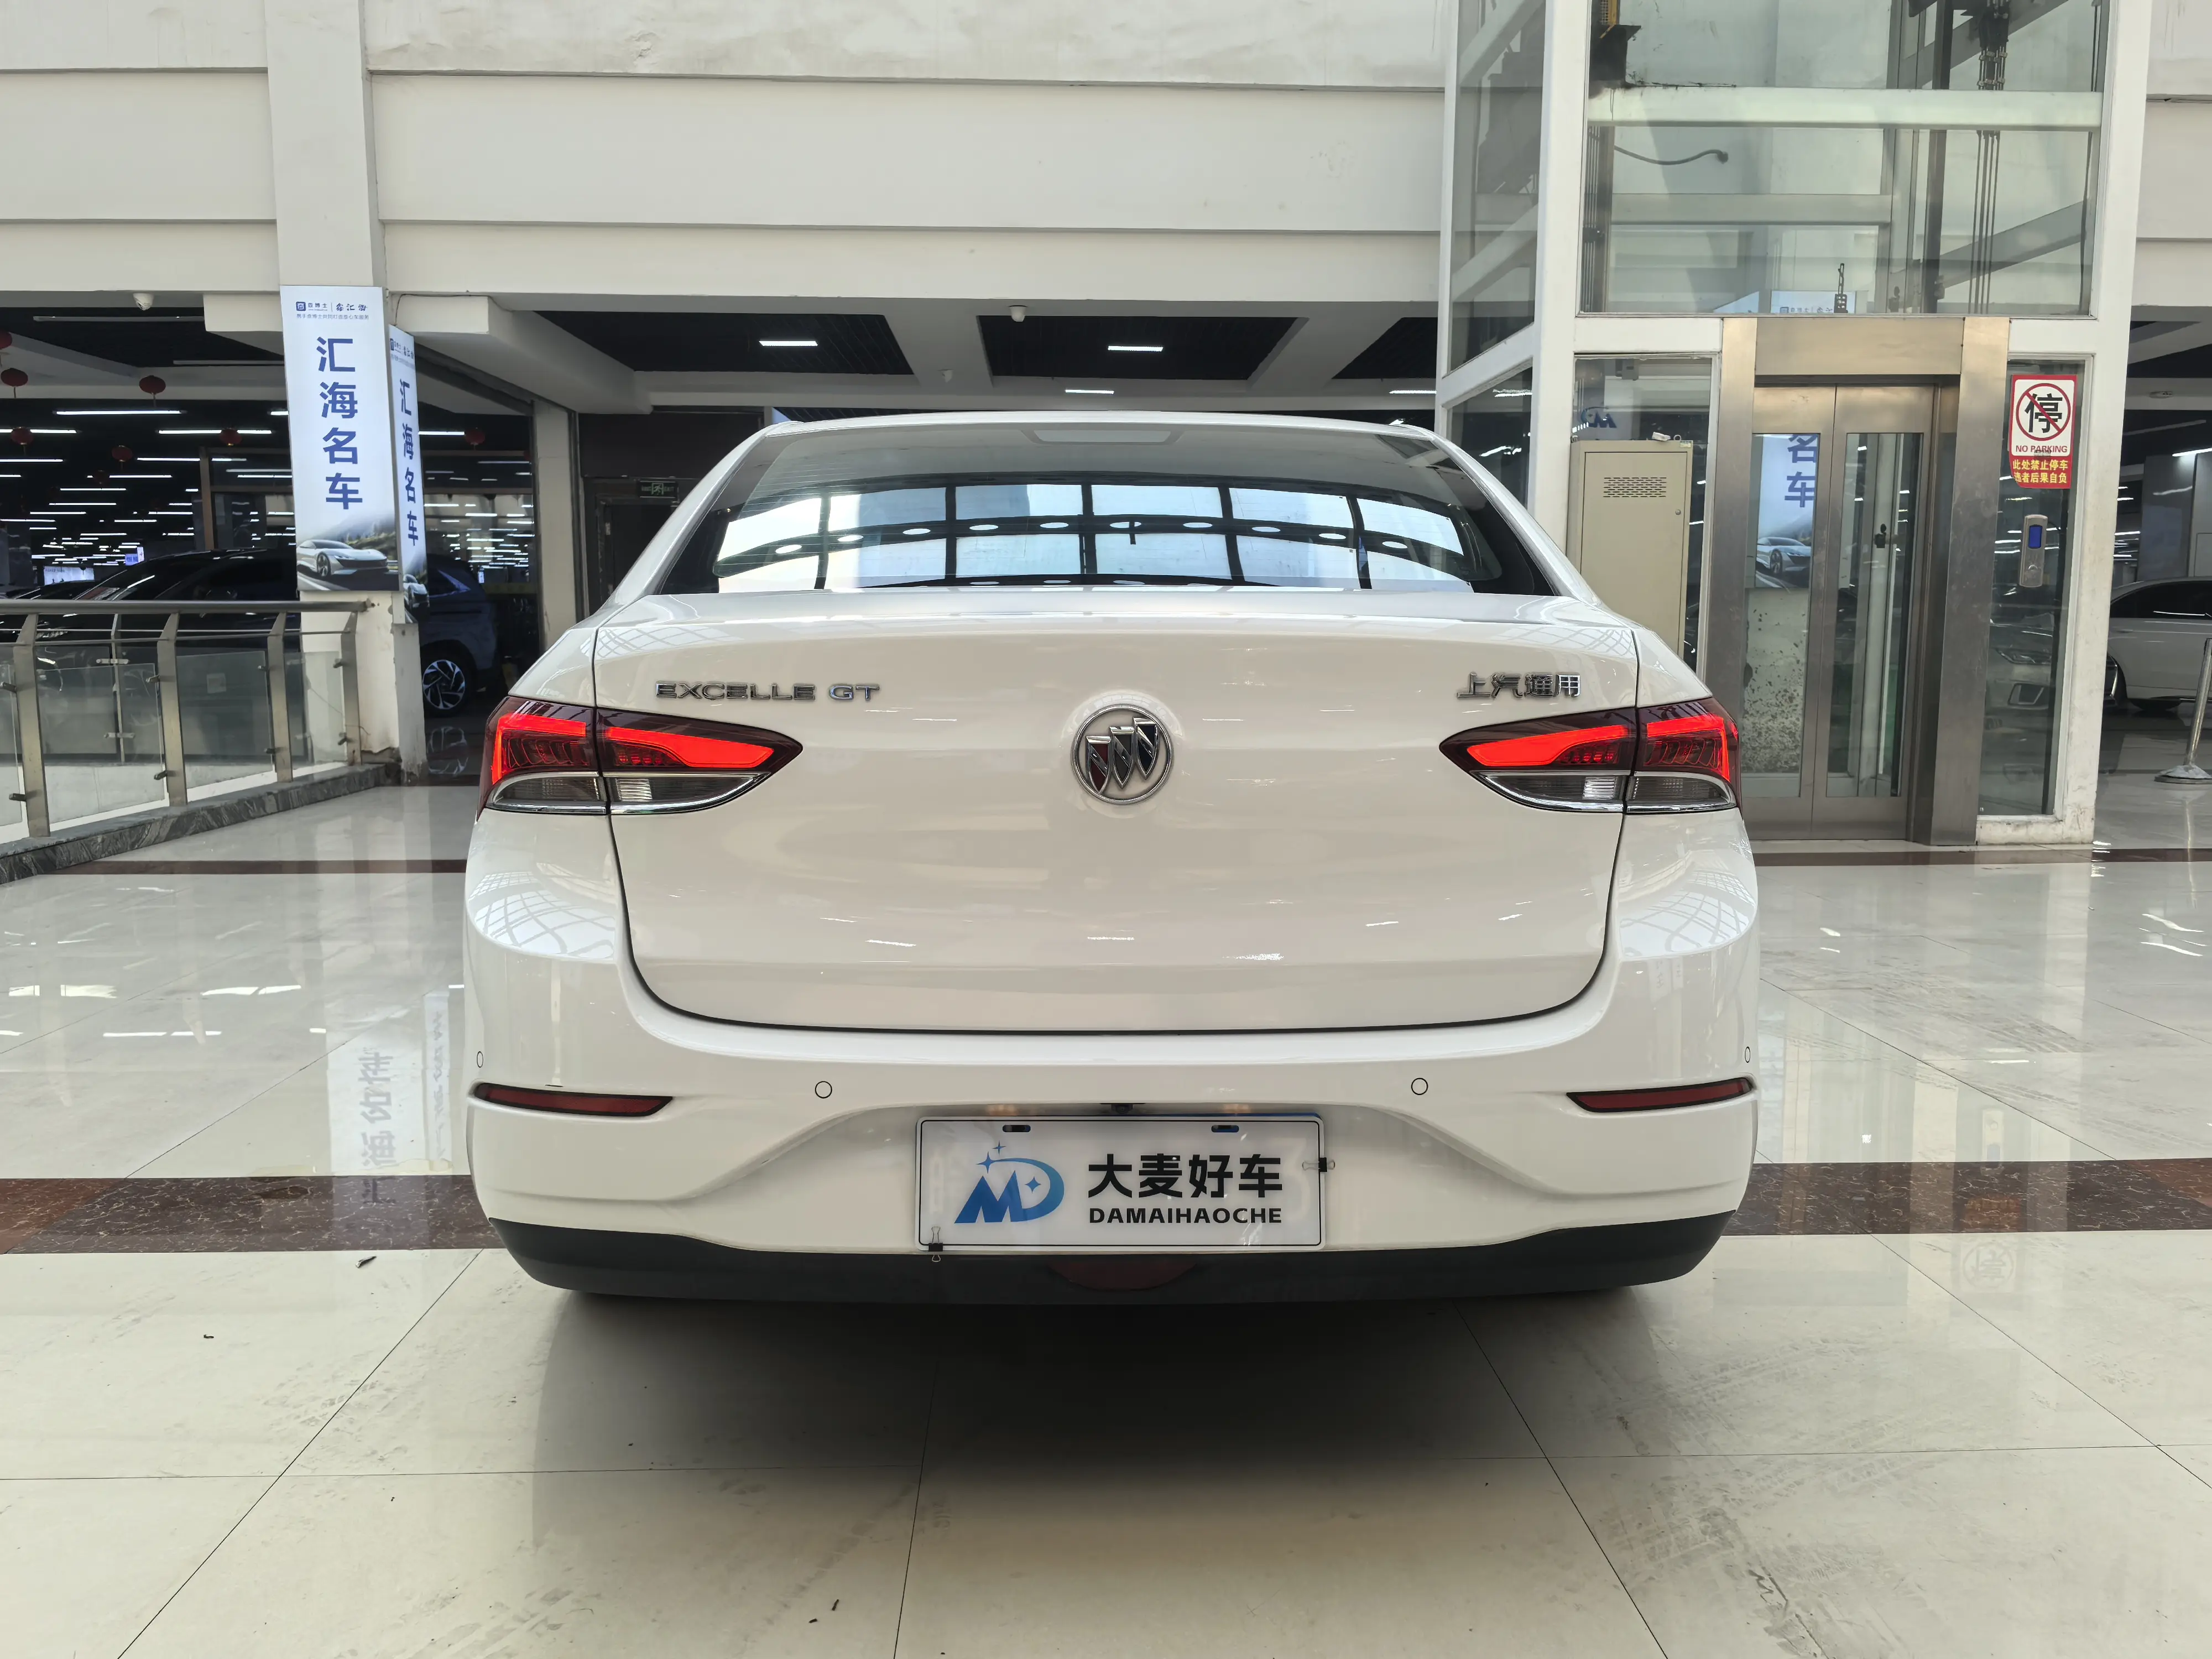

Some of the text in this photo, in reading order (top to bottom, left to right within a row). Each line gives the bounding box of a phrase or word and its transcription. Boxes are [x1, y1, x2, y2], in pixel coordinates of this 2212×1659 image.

[316, 336, 363, 509] 汇海名车
[2025, 393, 2063, 433] 停
[399, 378, 419, 546] 汇海名车
[2013, 460, 2068, 469] 此处禁止停车
[2013, 472, 2067, 483] 违者后果自负
[656, 681, 880, 701] EXCELLE GT
[1457, 672, 1580, 698] 上汽通用
[1088, 1154, 1282, 1198] 大麦好车
[1089, 1208, 1281, 1223] DAMAIHAOCHE
